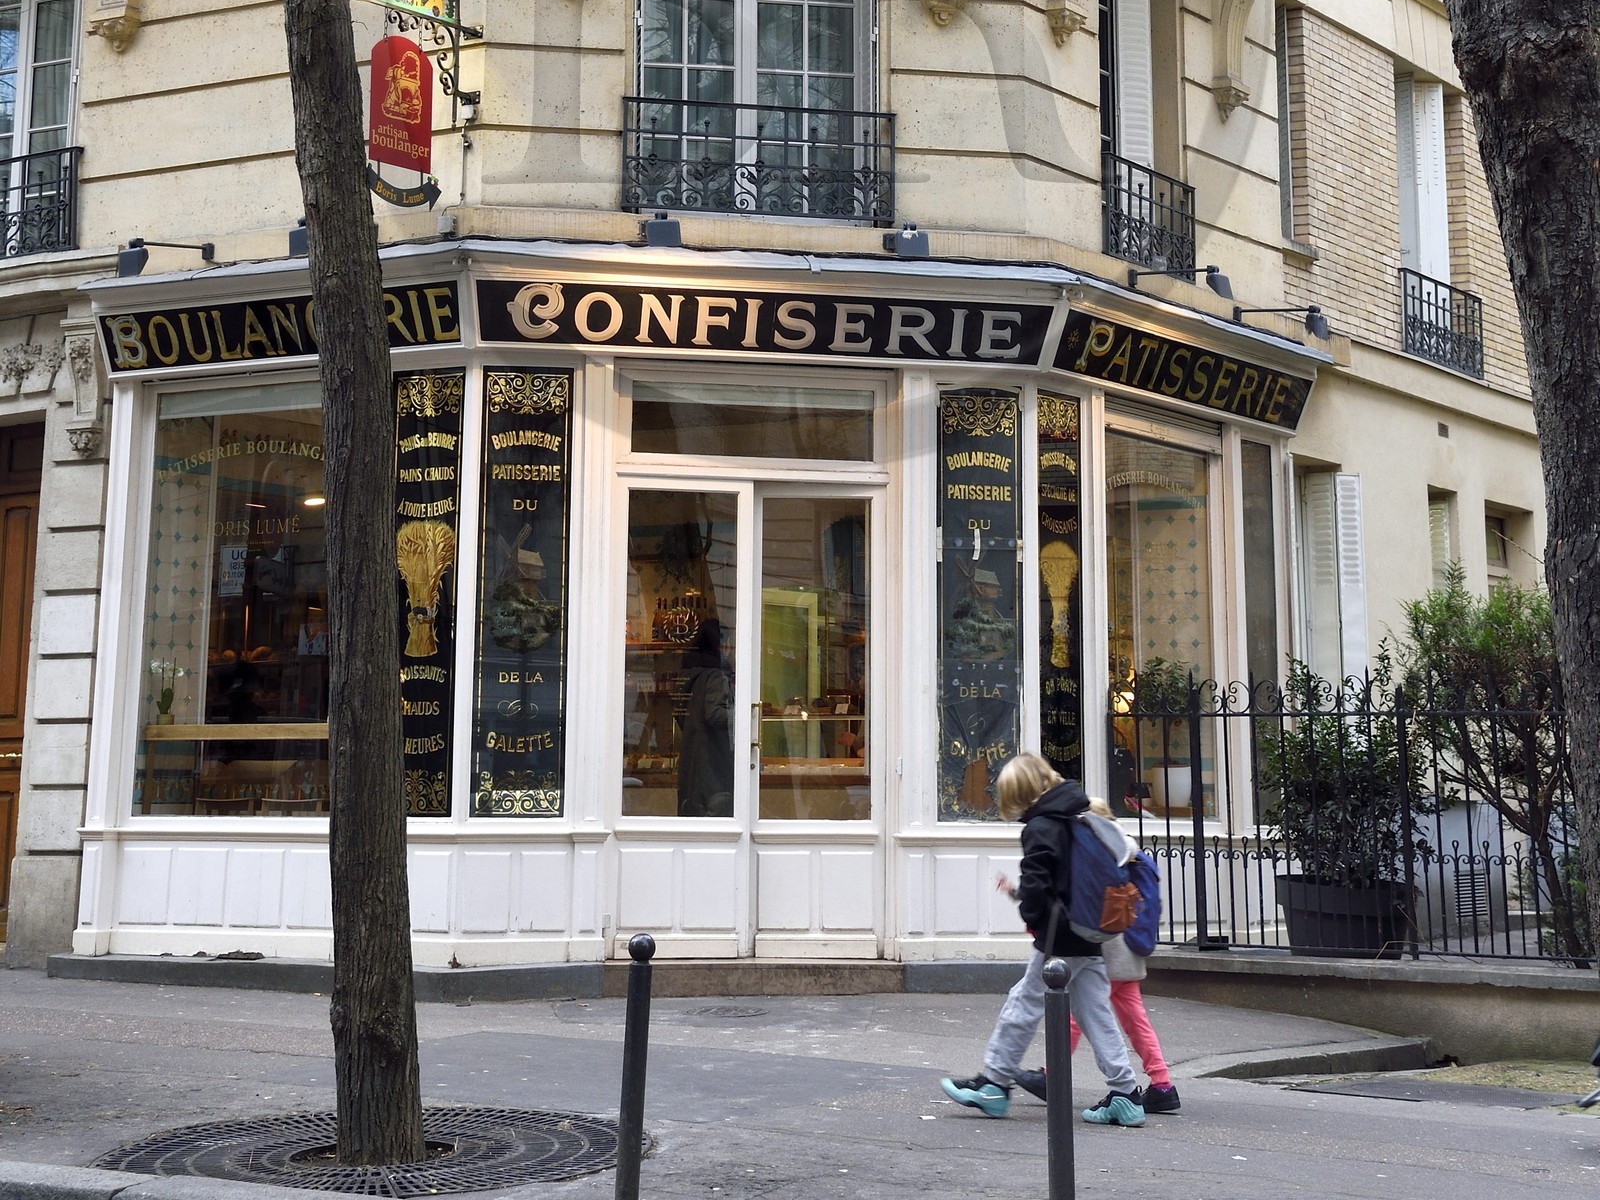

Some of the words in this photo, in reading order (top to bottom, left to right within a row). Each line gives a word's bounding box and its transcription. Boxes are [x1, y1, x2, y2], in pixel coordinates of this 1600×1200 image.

[378, 123, 409, 141] artisan
[372, 129, 430, 160] boulanger
[376, 180, 398, 204] Boris
[105, 287, 460, 370] BOULANRIE
[507, 283, 1022, 359] CONFISERIE
[1074, 319, 1291, 423] PATISSERIE
[399, 434, 421, 454] PAINS
[428, 432, 458, 451] BEURRE
[491, 429, 562, 453] BOULANGERIE
[159, 442, 242, 483] PÂTISSERIE
[247, 440, 325, 461] BOULANG
[492, 464, 561, 481] PATISSERIE
[946, 451, 1012, 473] BOULANGERIE
[400, 468, 422, 483] PAINS
[424, 466, 455, 481] CHAUDS
[947, 484, 1011, 502] PATISSERIE
[404, 500, 426, 518] TOUTE
[427, 496, 456, 517] HEURE
[512, 499, 538, 511] DU
[212, 520, 250, 537] ORIS
[256, 514, 301, 536] LUMÉ
[968, 518, 991, 530] DU
[499, 672, 520, 683] DE
[525, 672, 544, 683] LA
[960, 686, 979, 698] DE
[983, 686, 1002, 698] LA
[401, 698, 440, 716] HAUDS
[404, 733, 445, 754] HEURES
[485, 731, 554, 753] GALETTE
